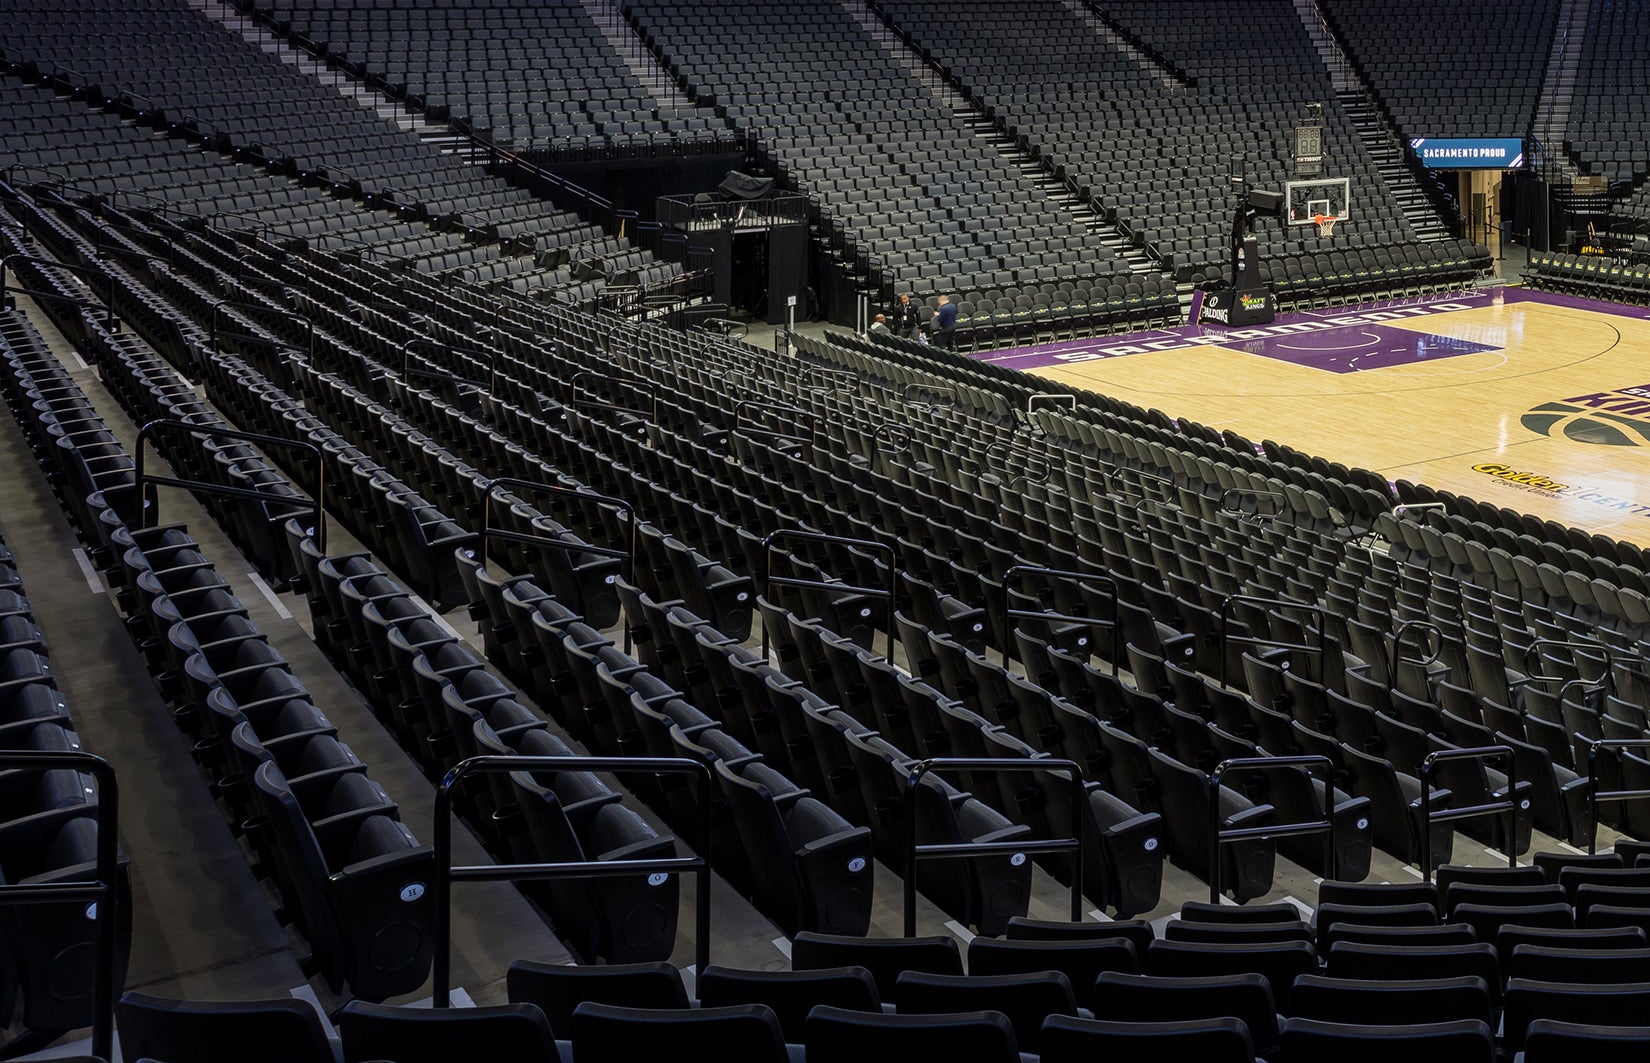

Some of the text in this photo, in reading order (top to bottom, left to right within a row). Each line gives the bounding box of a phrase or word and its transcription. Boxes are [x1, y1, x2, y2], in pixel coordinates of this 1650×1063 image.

[1424, 148, 1506, 159] SACRAMENTO PROUD
[1053, 304, 1473, 363] SACRAMENTO
[1471, 463, 1569, 493] Golden
[408, 888, 417, 897] H
